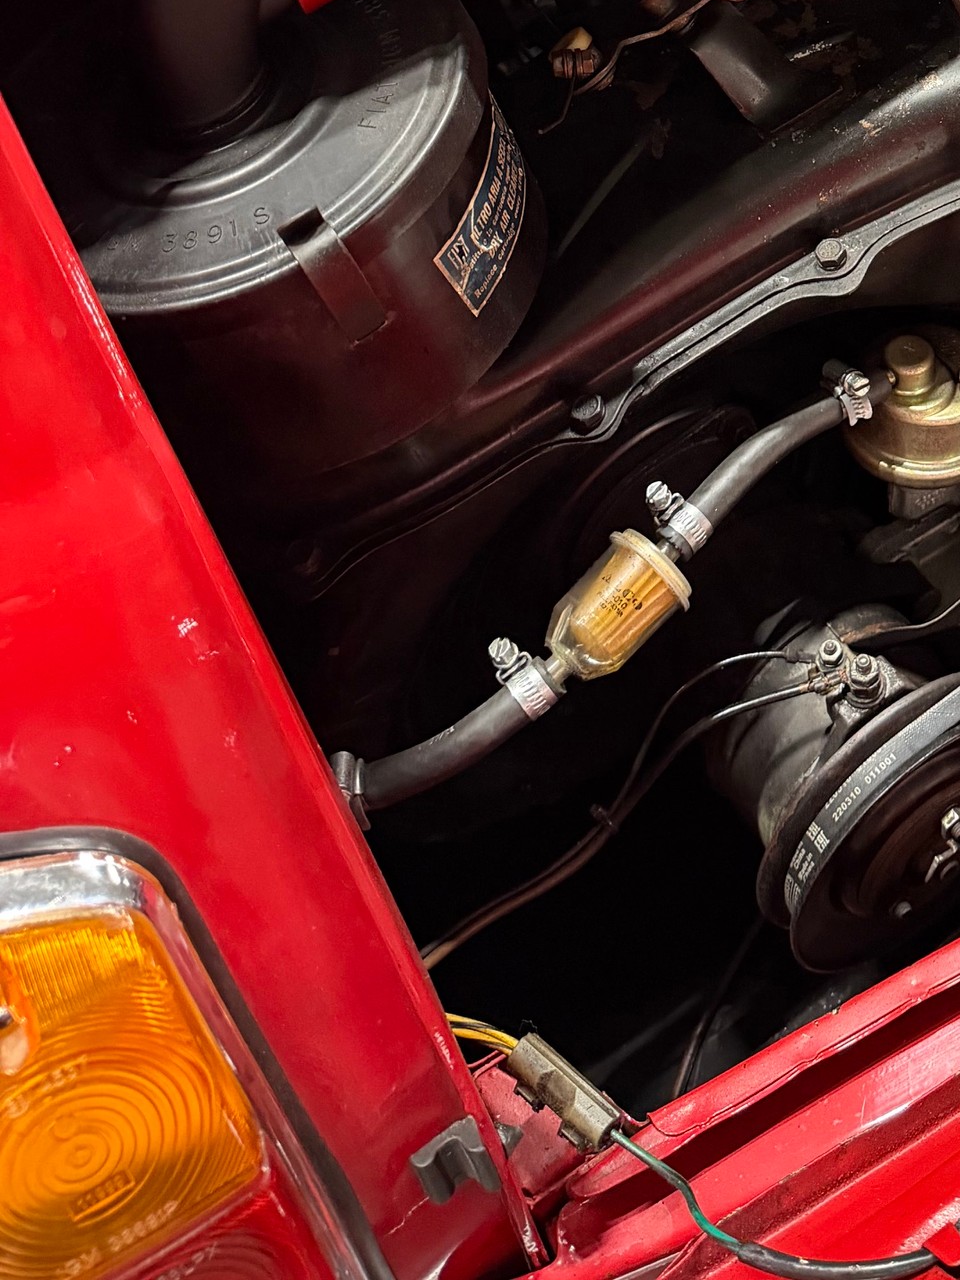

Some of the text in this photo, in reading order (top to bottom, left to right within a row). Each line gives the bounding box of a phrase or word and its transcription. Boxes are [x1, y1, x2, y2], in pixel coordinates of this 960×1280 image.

[357, 82, 399, 129] FIAT
[488, 176, 501, 207] ARIA
[496, 166, 503, 180] A
[161, 219, 238, 253] 3891
[253, 207, 270, 224] S
[489, 231, 503, 259] DRY
[500, 209, 511, 233] AIR
[474, 264, 498, 299] Replace
[832, 786, 862, 822] 220310
[864, 753, 897, 785] 011001
